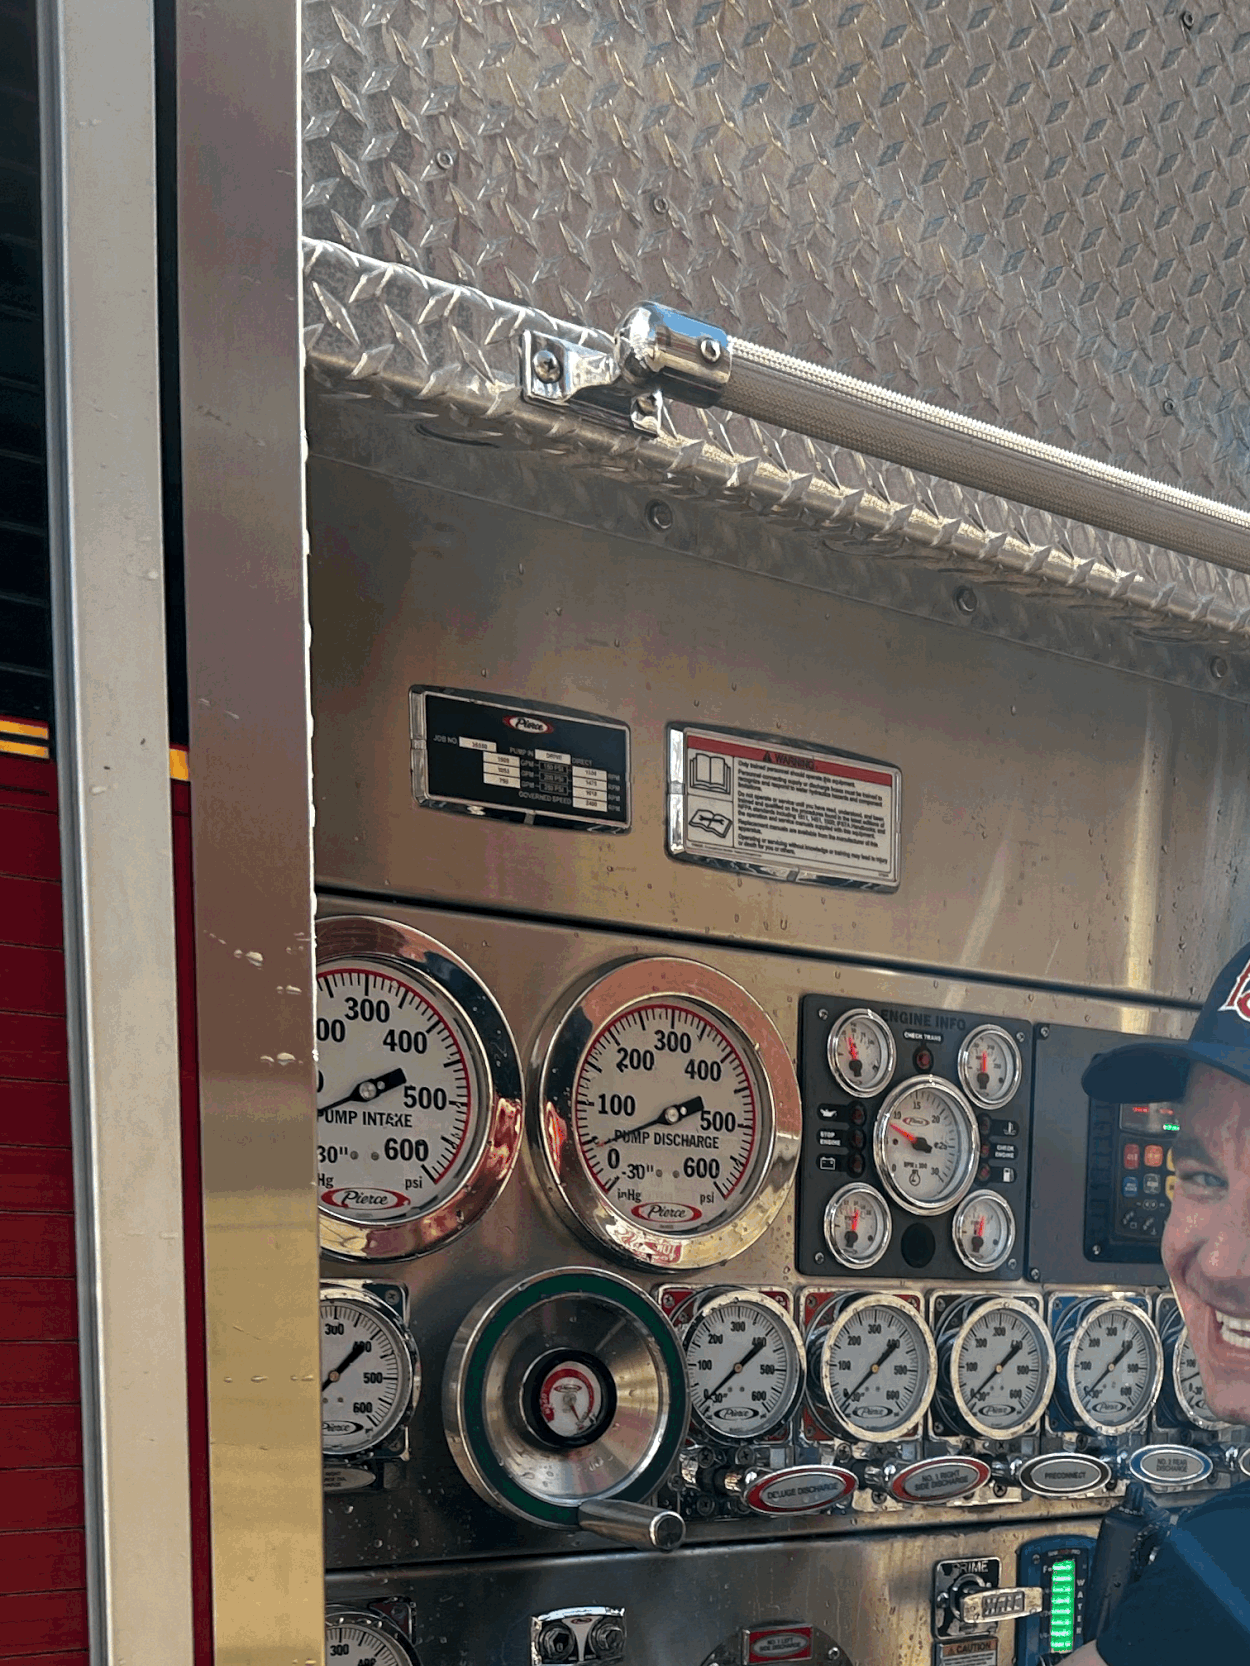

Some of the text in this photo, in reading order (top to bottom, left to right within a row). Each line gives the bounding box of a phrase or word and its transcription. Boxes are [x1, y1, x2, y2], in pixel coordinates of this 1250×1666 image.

[433, 734, 446, 743] JOB
[775, 753, 815, 771] WARNING
[344, 997, 390, 1023] 300
[880, 1009, 966, 1030] ENGINE INFO
[316, 1018, 428, 1054] 00 400
[654, 1030, 691, 1053] 300
[904, 1031, 923, 1039] CHECK
[616, 1047, 721, 1081] 200 400
[403, 1085, 447, 1110] 500
[598, 1094, 636, 1116] 100
[913, 1101, 921, 1110] 15
[363, 1111, 413, 1128] INTAKE
[700, 1110, 736, 1133] 500
[932, 1114, 940, 1124] 20
[615, 1129, 719, 1149] PUMP DISCHARGE
[820, 1138, 841, 1146] ENGINE
[384, 1138, 429, 1161] 600
[608, 1148, 720, 1180] 0 -30" 600
[931, 1167, 939, 1176] 30
[405, 1176, 423, 1190] psi
[341, 1190, 388, 1207] Pierce
[617, 1188, 714, 1205] inHg psi
[647, 1204, 687, 1219] Pierce
[325, 1323, 345, 1335] 300
[730, 1321, 746, 1332] 300
[868, 1324, 882, 1334] 300
[708, 1333, 723, 1344] 200
[848, 1336, 861, 1346] 200
[698, 1360, 775, 1375] 100 500
[838, 1360, 908, 1375] 100 500
[966, 1362, 1029, 1375] 100 500
[1080, 1361, 1092, 1371] 100
[363, 1372, 383, 1384] 500
[752, 1391, 767, 1401] 600
[886, 1390, 900, 1400] 600
[1009, 1389, 1022, 1399] 600
[353, 1401, 372, 1414] 600
[724, 1408, 749, 1419] Pierce
[941, 1469, 960, 1479] RIGHT
[1156, 1464, 1188, 1473] DISCHARGE
[914, 1475, 968, 1491] SIDE DISCHARGE
[767, 1482, 838, 1499] DELUGE DISCHARGE
[330, 1644, 349, 1656] 300
[956, 1642, 991, 1654] CAUTION
